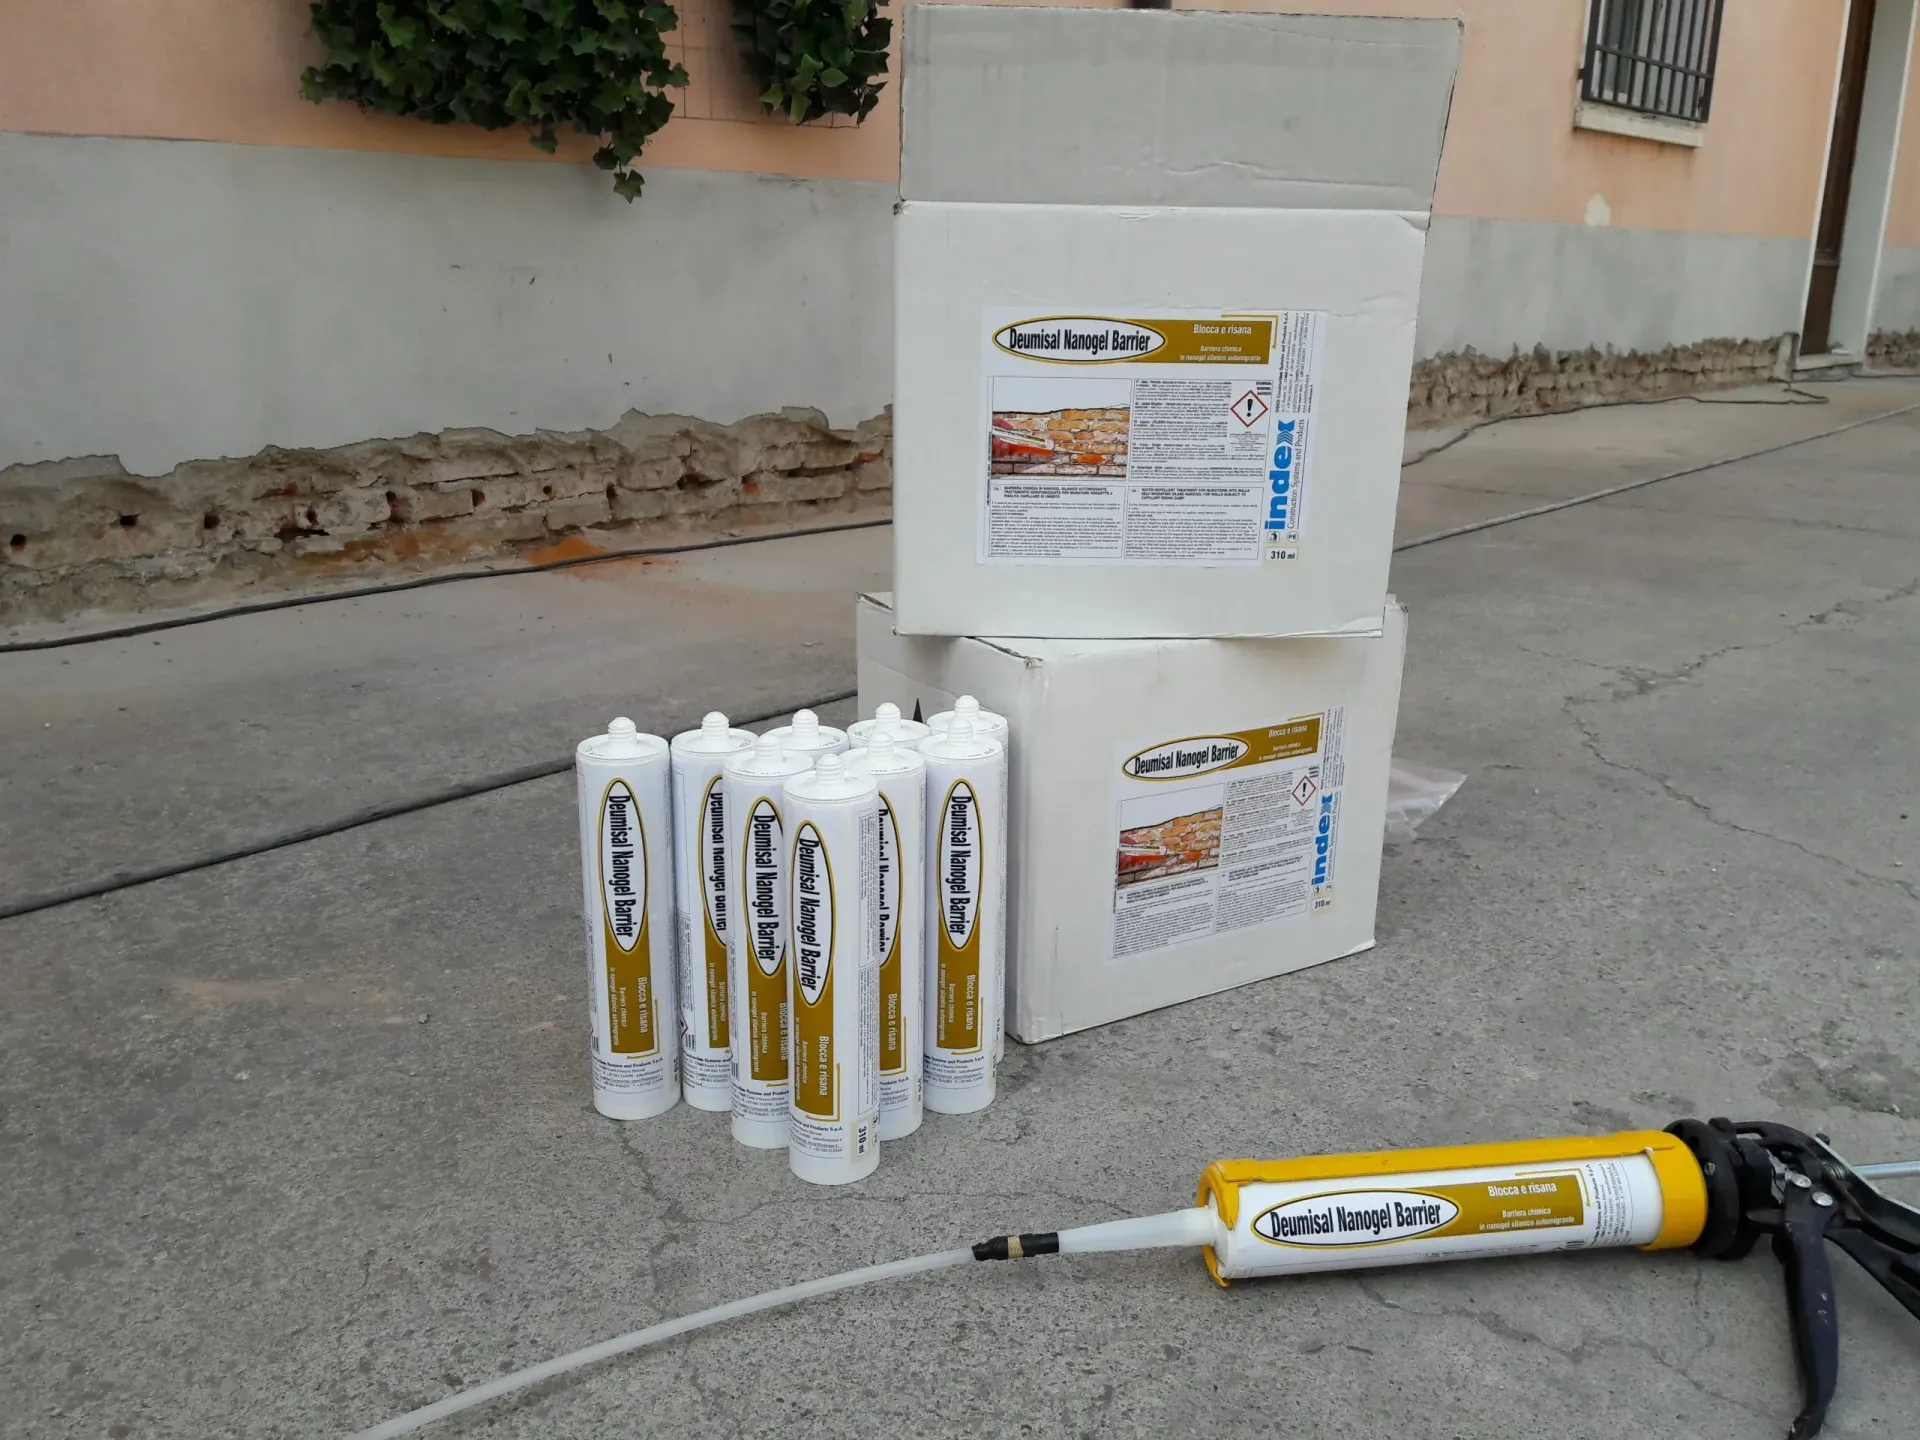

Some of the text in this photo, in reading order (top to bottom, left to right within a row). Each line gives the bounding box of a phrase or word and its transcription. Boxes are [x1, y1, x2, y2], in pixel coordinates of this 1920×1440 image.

[1009, 327, 1151, 355] Deumisal Nanogel Barrier
[1193, 324, 1219, 334] Blocca
[1228, 324, 1252, 334] risana
[1294, 418, 1304, 447] Products
[1264, 419, 1296, 530] index
[1291, 462, 1301, 488] Systems
[1287, 489, 1298, 530] Construction
[1270, 551, 1286, 560] 310
[1134, 742, 1239, 775] Deumisal Nanogel Barrier
[1311, 793, 1333, 885] index
[608, 795, 638, 938] Deumisal Nanogel Barrier
[945, 795, 972, 935] Deumisal Nanogel Barrier
[752, 815, 780, 961] Deumisal Nanogel Barrier
[797, 838, 821, 990] Deumisal Nanogel Barrier
[1314, 900, 1325, 909] 310
[637, 976, 648, 1003] Blocca
[966, 974, 976, 1000] Blocca
[888, 993, 898, 1019] Blocca
[966, 1008, 975, 1030] risana
[639, 1012, 648, 1034] risana
[819, 1035, 830, 1063] Blocca
[888, 1028, 898, 1051] risana
[819, 1072, 830, 1096] risana
[857, 1126, 867, 1154] 310 ml
[1488, 1182, 1557, 1197] Blocca e risana
[1270, 1199, 1441, 1238] Deumisal Nanogel Barrier
[1486, 1221, 1511, 1230] nanogel
[1511, 1219, 1535, 1228] silanico
[1535, 1216, 1575, 1226] automigrante
[1502, 1206, 1552, 1218] Barriera chimica
